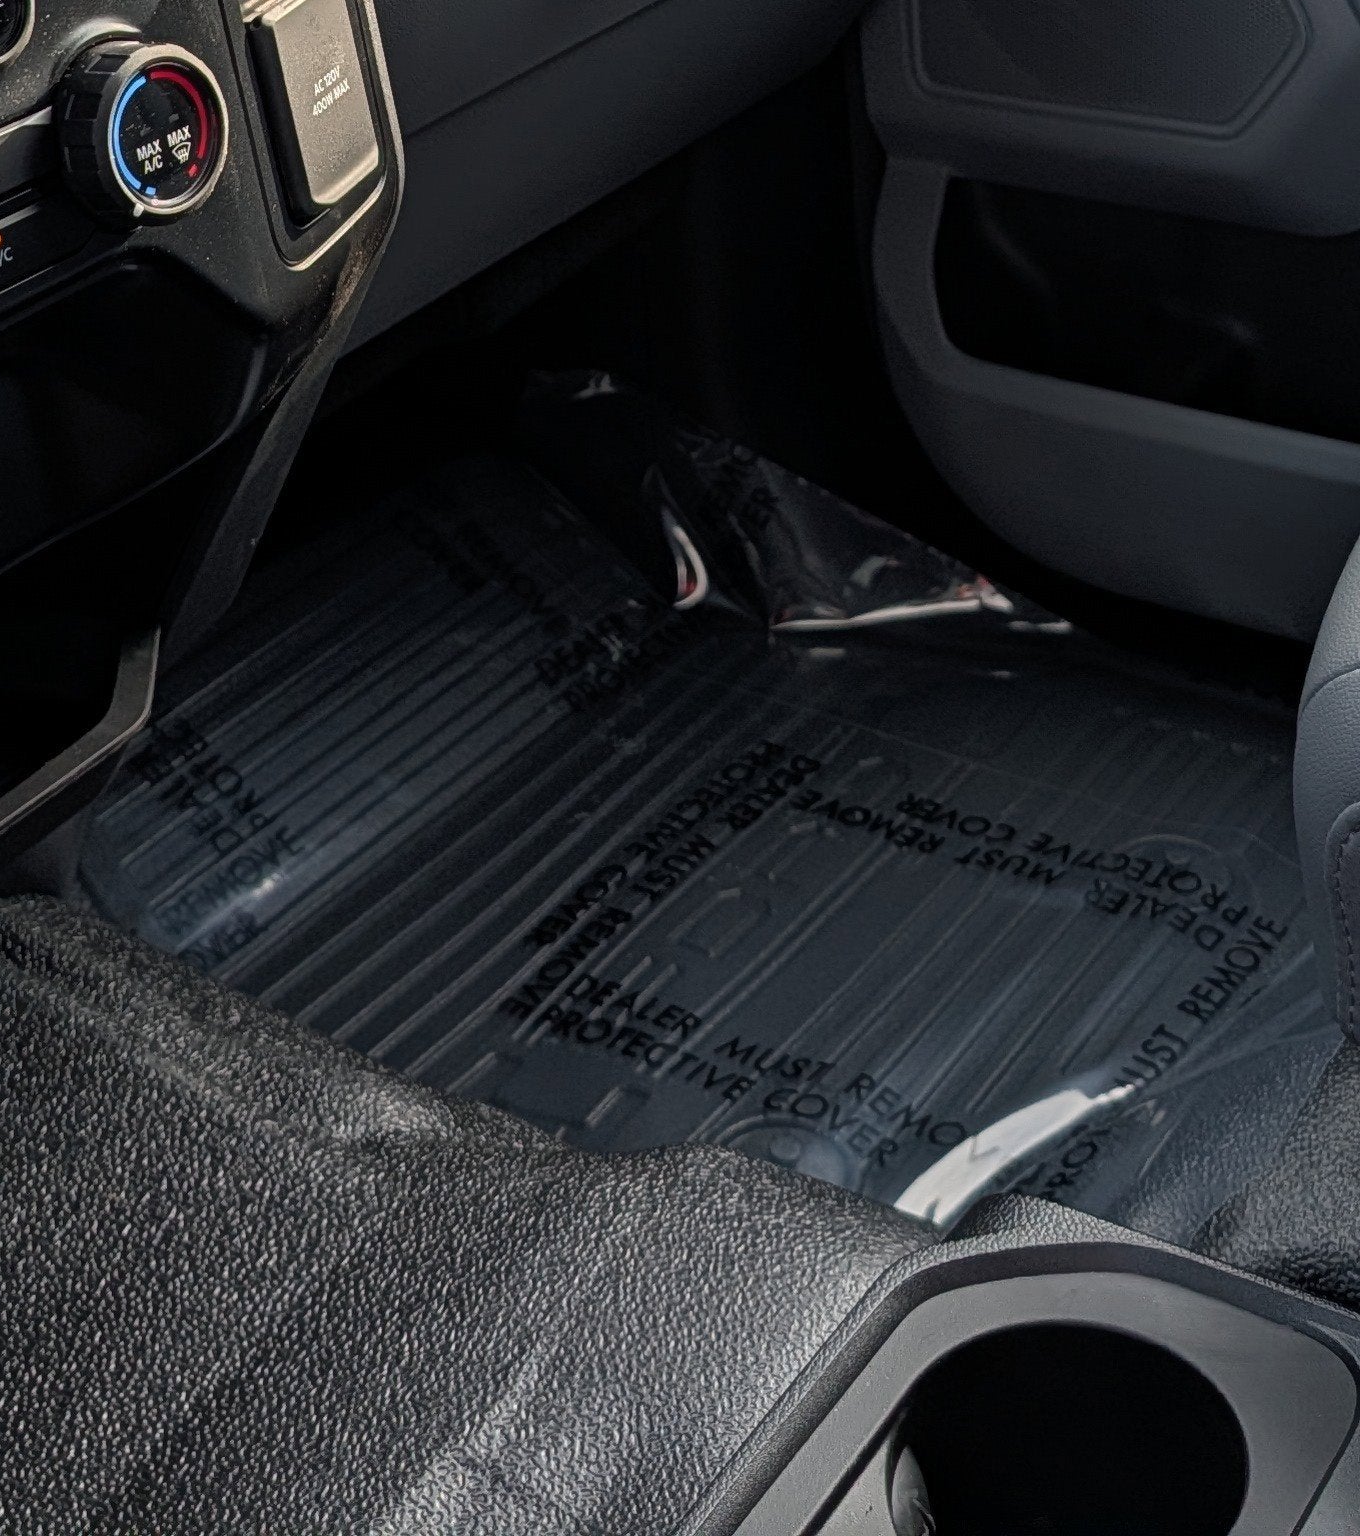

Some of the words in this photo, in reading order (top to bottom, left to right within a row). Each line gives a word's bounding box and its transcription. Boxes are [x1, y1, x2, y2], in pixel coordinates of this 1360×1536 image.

[312, 91, 334, 117] 400W
[332, 77, 351, 101] MAX
[314, 78, 325, 97] AC
[323, 64, 340, 88] 120V
[136, 138, 163, 162] MAX
[143, 154, 164, 175] A/C
[166, 124, 192, 148] MAX
[790, 787, 947, 855] REMOVE
[894, 791, 1017, 844] COVER
[632, 833, 718, 902] MUST
[954, 845, 1067, 888] MUST
[1024, 830, 1254, 925] PROTECTIVE
[1083, 878, 1227, 954] DEALER
[497, 906, 632, 1020] REMOVE
[1176, 914, 1290, 1023] REMOVE
[570, 973, 703, 1041] DEALER
[714, 1035, 840, 1084] MUST
[539, 1002, 755, 1103] PROTECTIVE
[762, 1085, 900, 1166] COVER
